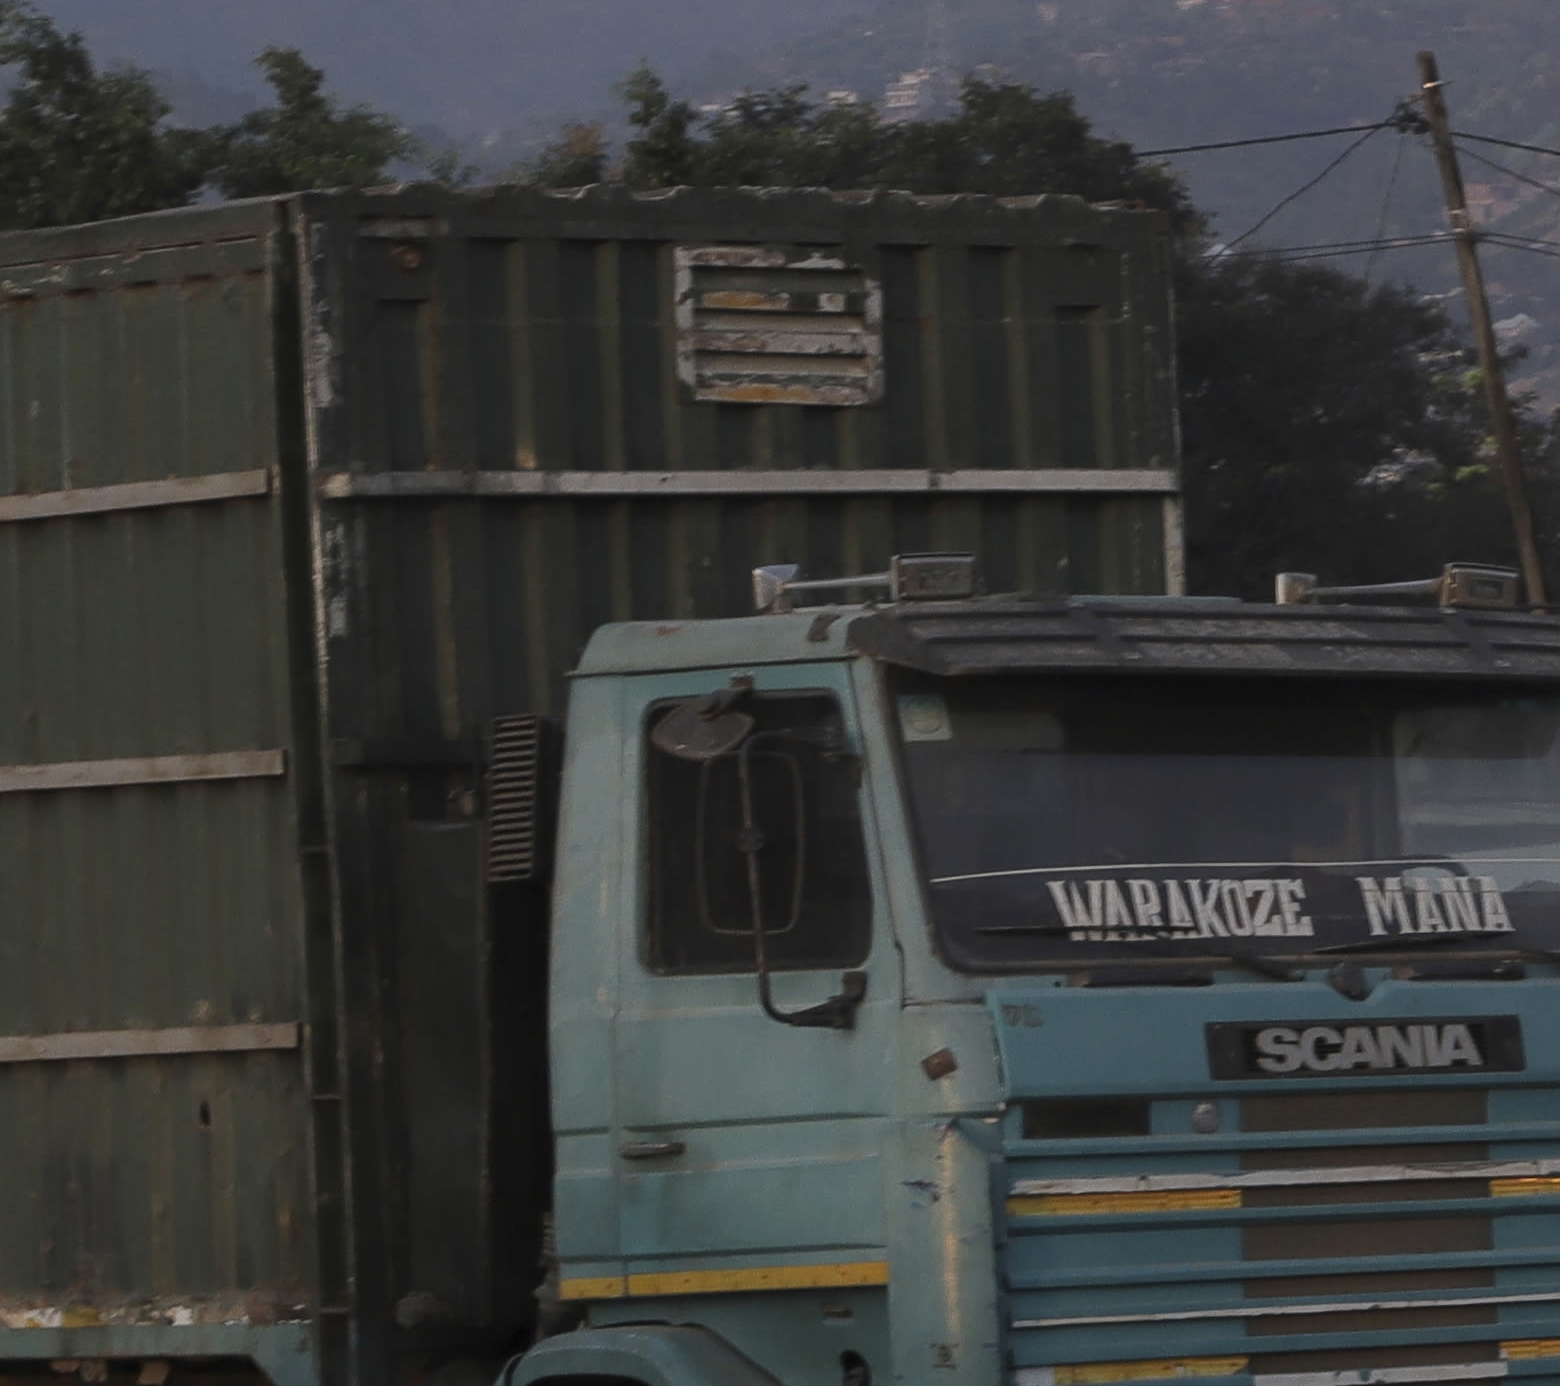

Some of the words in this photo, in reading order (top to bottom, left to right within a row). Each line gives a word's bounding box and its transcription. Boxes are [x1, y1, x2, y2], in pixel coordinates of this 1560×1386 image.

[1048, 877, 1315, 942] WARAKOZE
[1356, 875, 1516, 936] MANA
[1255, 1023, 1482, 1073] SCANIA
